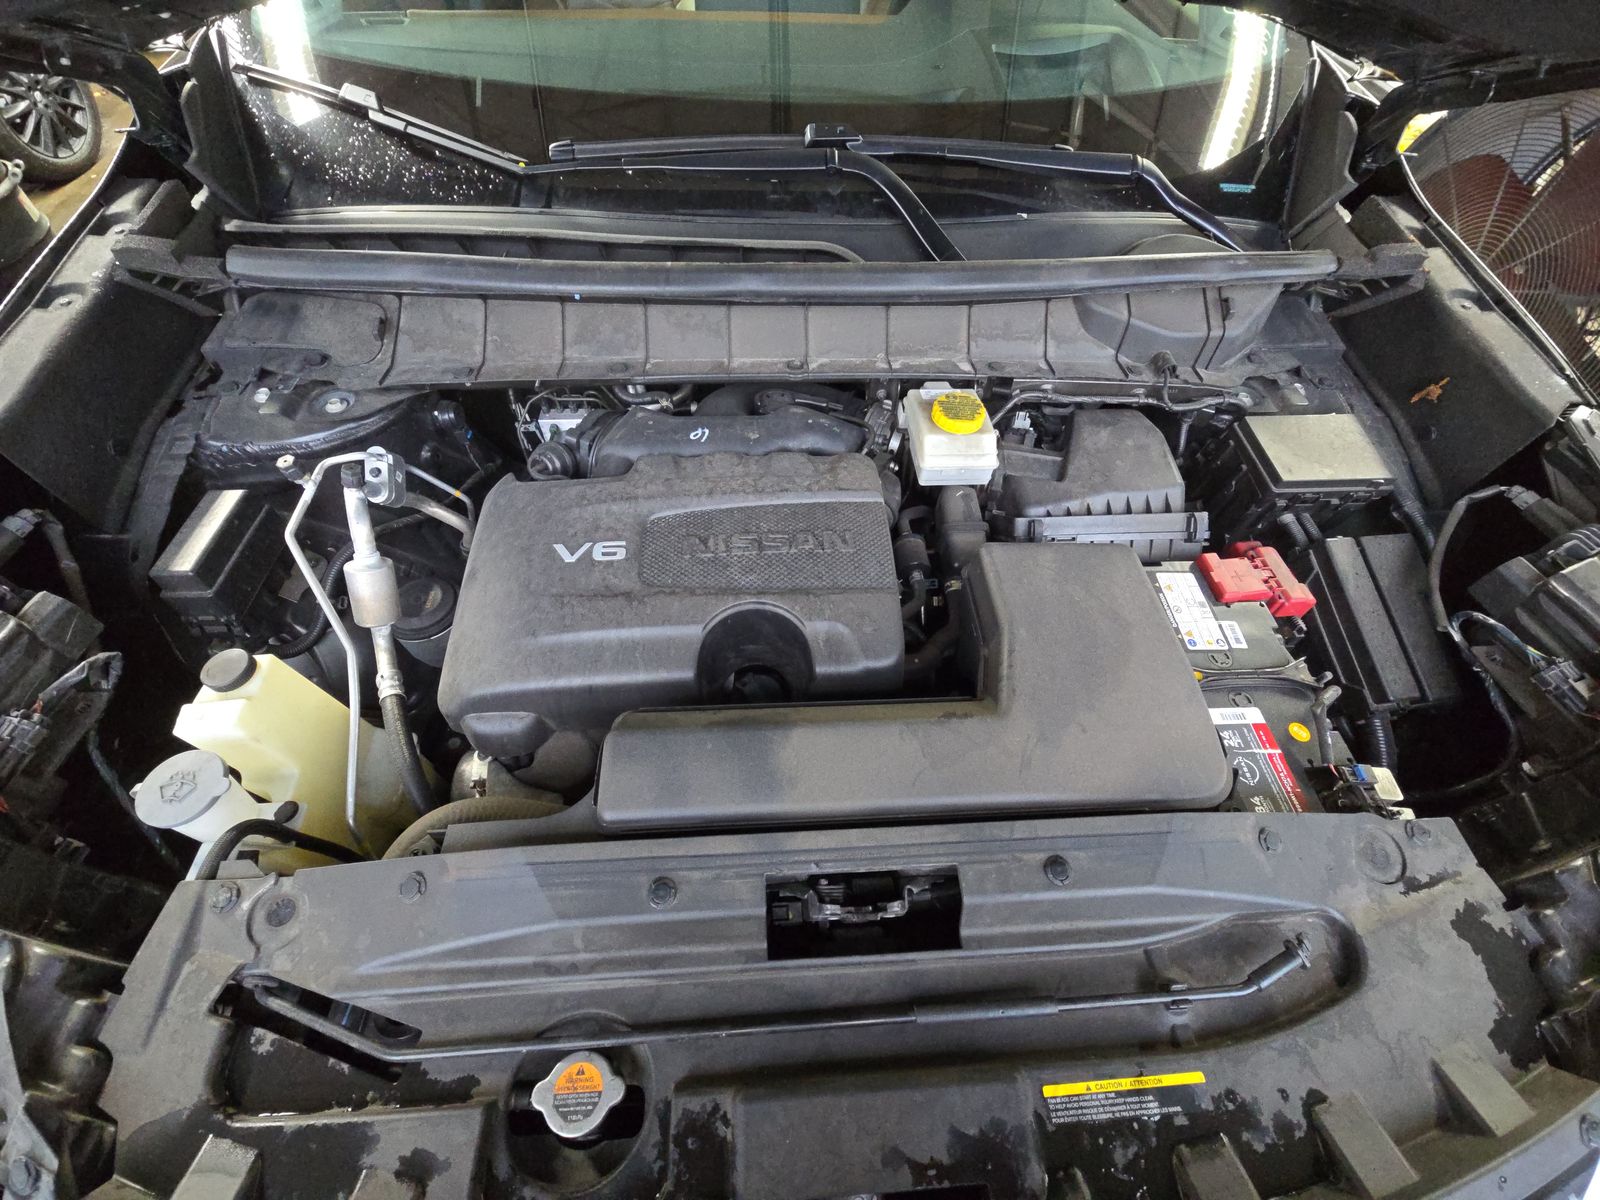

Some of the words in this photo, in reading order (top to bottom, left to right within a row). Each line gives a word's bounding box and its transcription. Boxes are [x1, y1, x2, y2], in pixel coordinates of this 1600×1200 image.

[553, 541, 627, 562] V6
[687, 530, 851, 558] NISSAN
[1220, 730, 1236, 747] 24
[1238, 757, 1254, 785] NISSAN
[1095, 1082, 1123, 1091] CAUTION
[1129, 1078, 1163, 1087] ATTENTION
